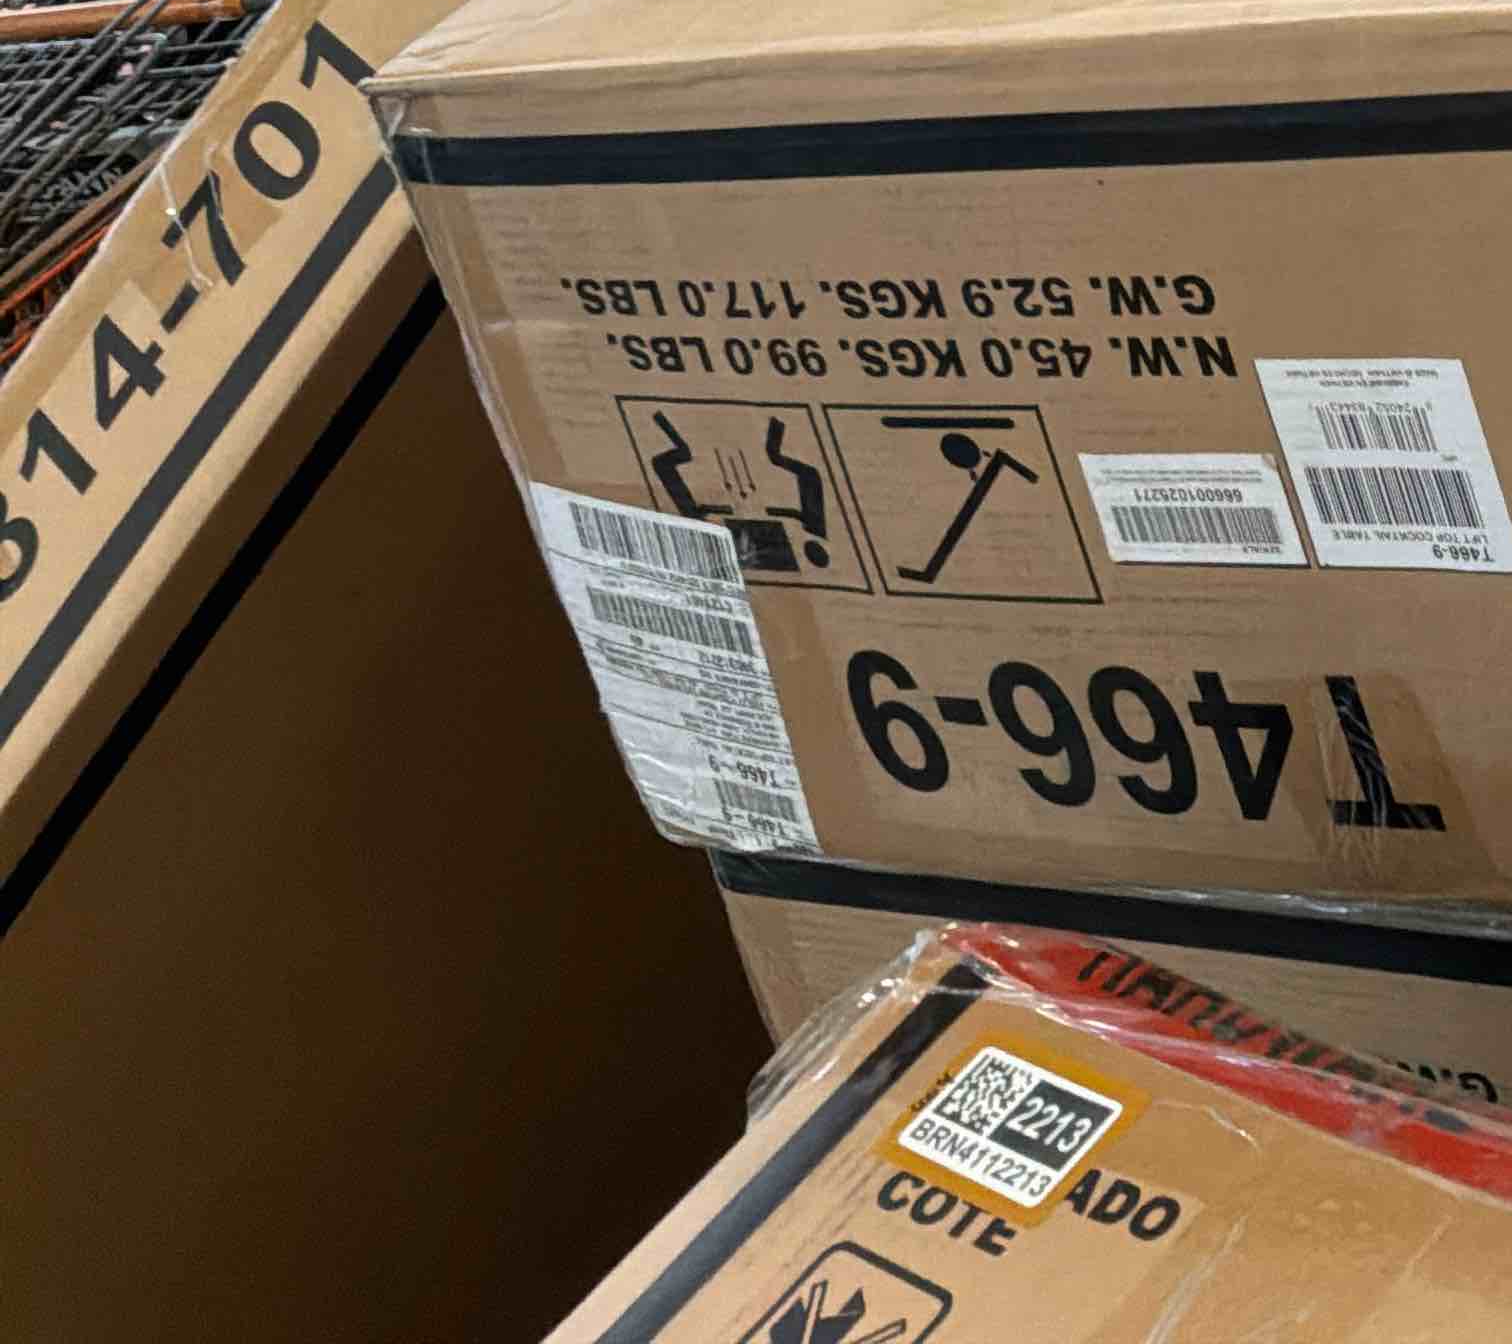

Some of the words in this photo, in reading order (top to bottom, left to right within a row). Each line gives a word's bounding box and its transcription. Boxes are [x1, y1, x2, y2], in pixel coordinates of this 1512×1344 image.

[560, 276, 667, 317] LBS.
[678, 276, 807, 318] 117.0
[820, 275, 945, 317] KGS.
[962, 275, 1074, 317] 52.9
[1089, 272, 1216, 316] G.W.
[606, 332, 714, 375] LBS.
[729, 335, 827, 378] 99.0
[839, 337, 966, 378] KGS.
[984, 336, 1091, 378] 45.0
[1109, 334, 1239, 378] N.W.
[1431, 543, 1493, 562] T466-9
[846, 649, 1447, 834] T466-9
[1008, 1096, 1092, 1154] 2213
[909, 1119, 1050, 1200] BRN4112213
